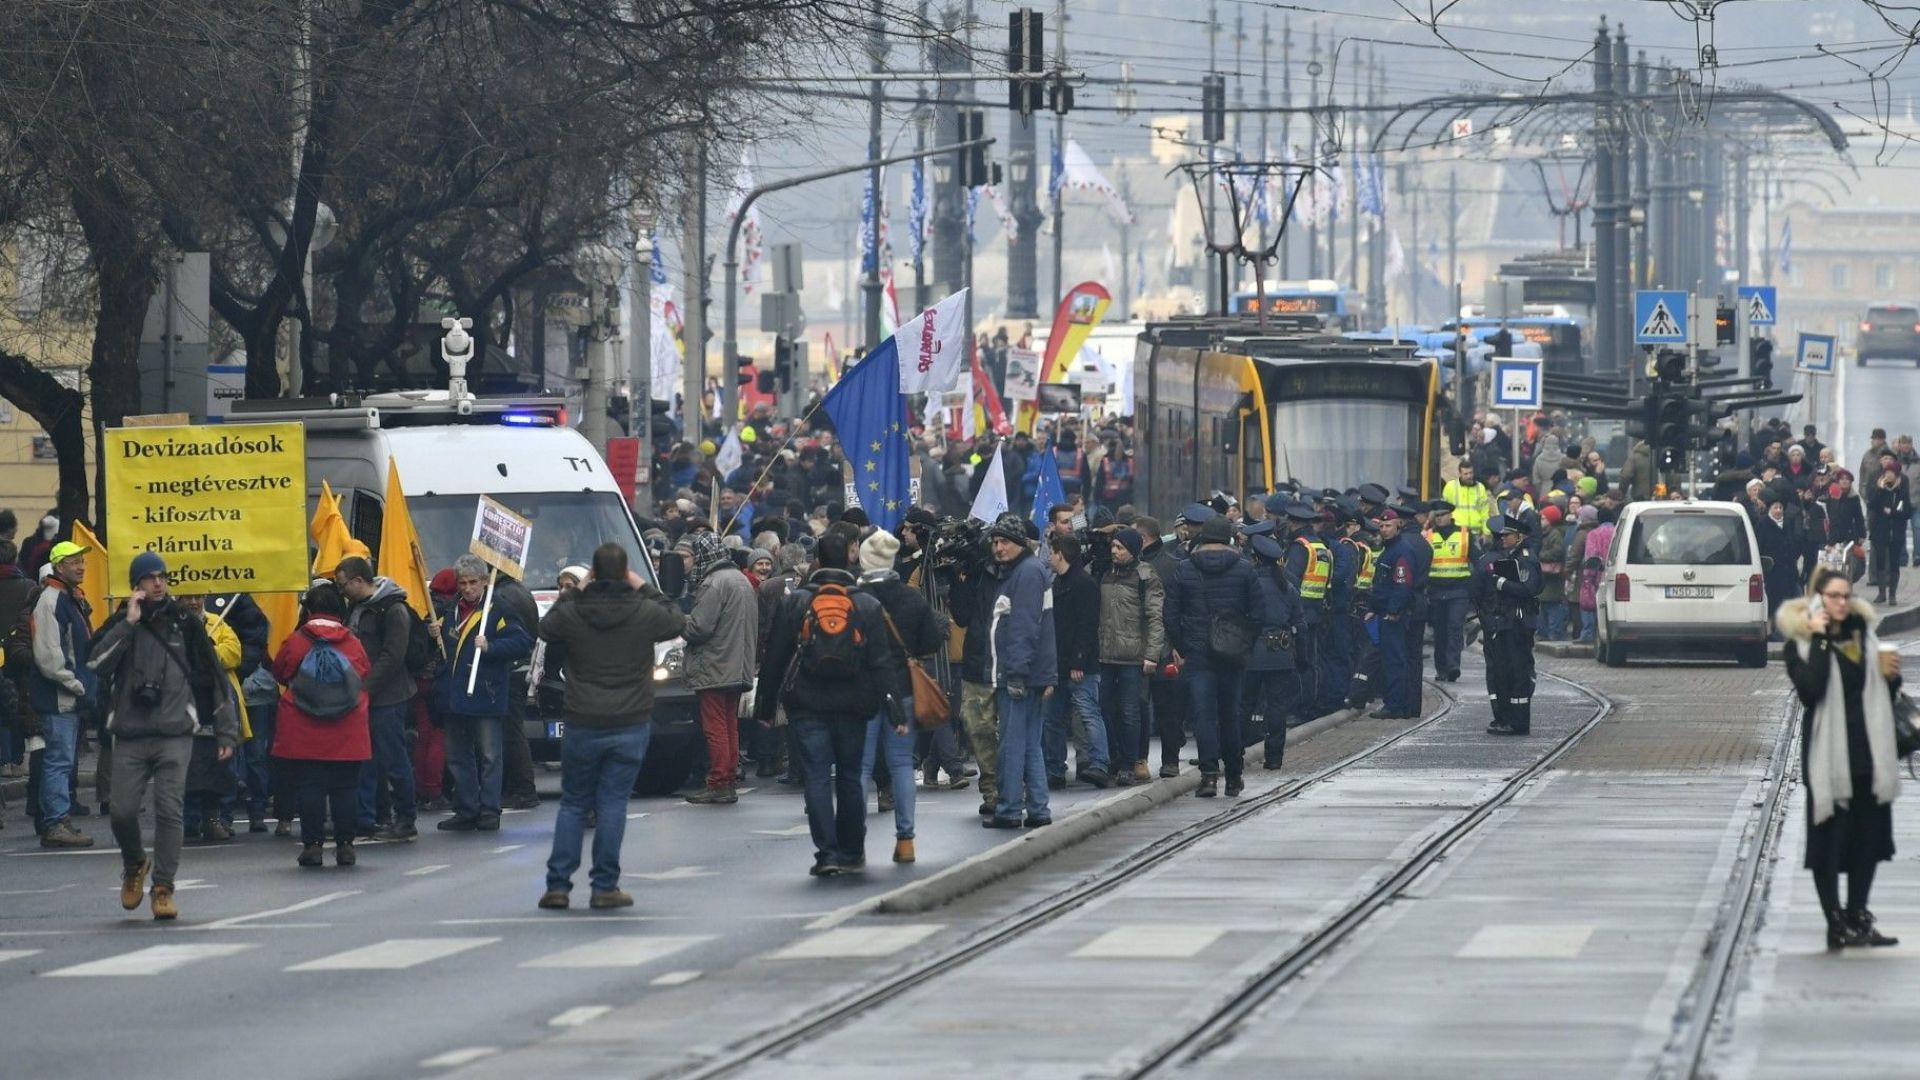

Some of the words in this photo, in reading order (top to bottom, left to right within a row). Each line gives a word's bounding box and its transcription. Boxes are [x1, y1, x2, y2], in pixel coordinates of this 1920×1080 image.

[122, 434, 284, 458] Devizaadósok
[562, 456, 593, 473] T1
[148, 474, 291, 496] megtévesztve
[145, 506, 242, 523] kifosztva
[146, 534, 234, 554] elárulva
[167, 564, 256, 587] gfosztva
